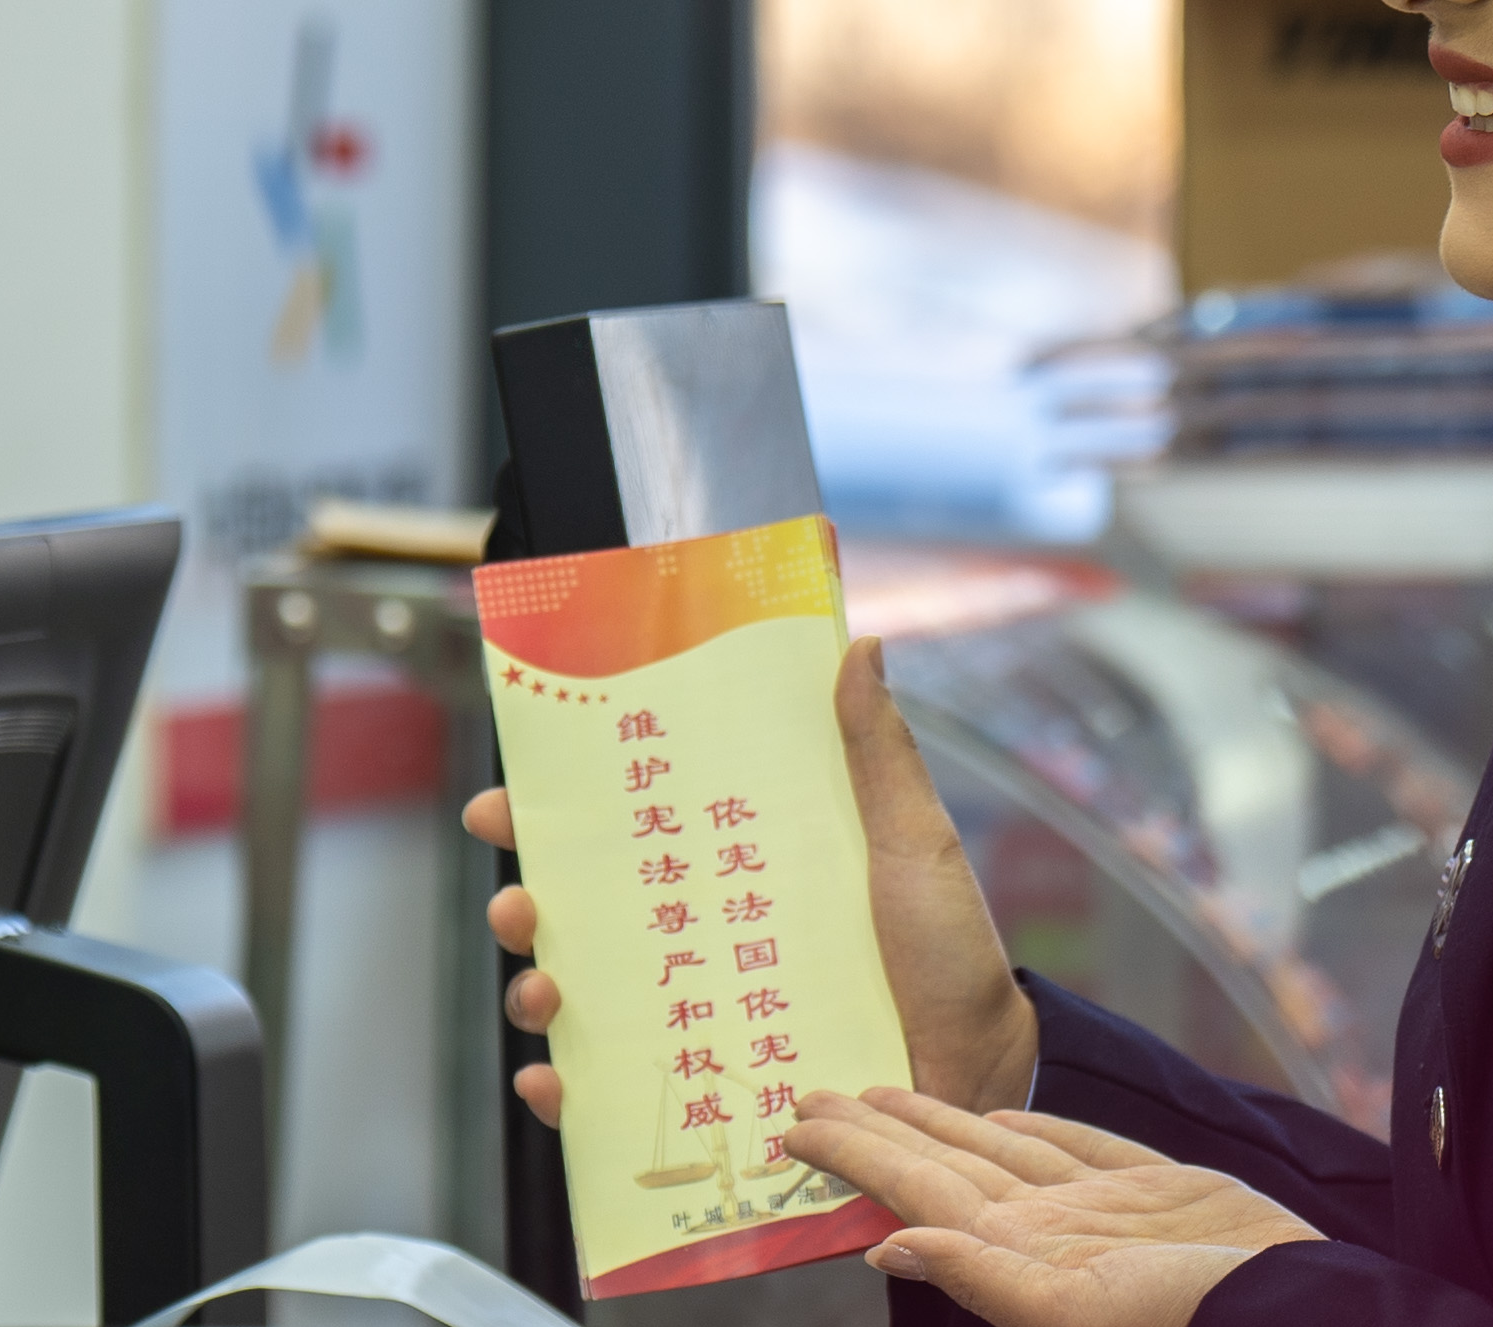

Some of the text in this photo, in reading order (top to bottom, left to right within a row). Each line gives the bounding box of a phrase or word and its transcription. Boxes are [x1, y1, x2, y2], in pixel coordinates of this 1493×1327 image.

[616, 708, 733, 1131] 维护宪法尊严和权威
